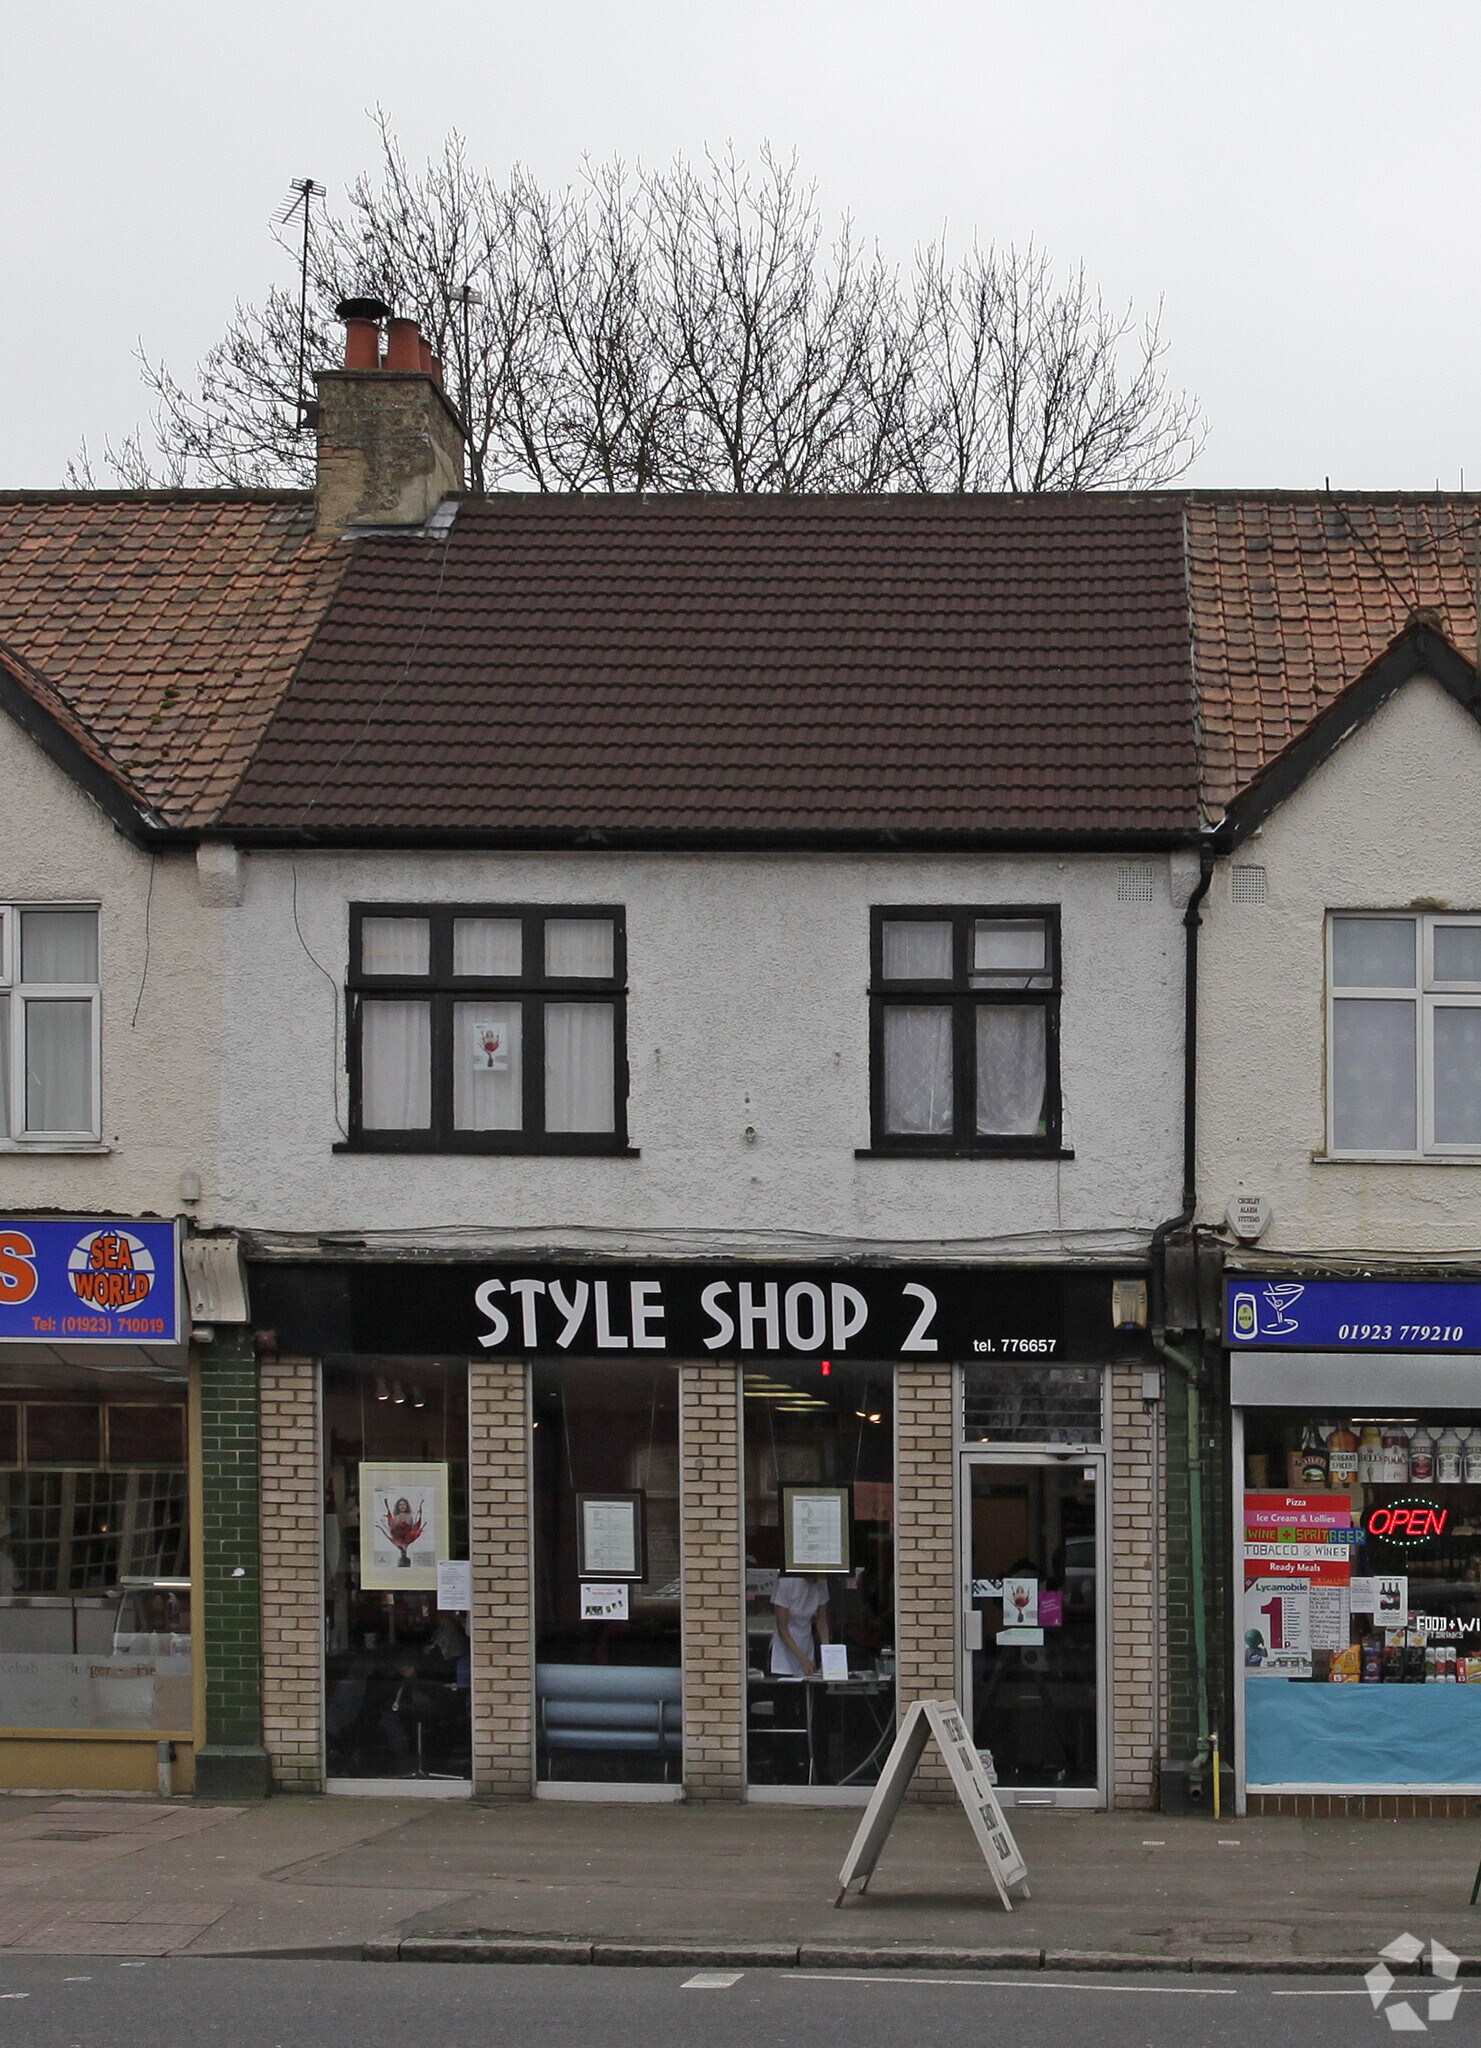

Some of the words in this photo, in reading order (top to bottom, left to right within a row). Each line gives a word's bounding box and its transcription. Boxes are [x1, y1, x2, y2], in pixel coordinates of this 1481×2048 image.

[1240, 1206, 1258, 1214] ALARM
[1237, 1215, 1261, 1223] SYSTEMS
[89, 1235, 134, 1270] SEA
[73, 1272, 150, 1307] WORLD
[474, 1278, 667, 1349] STYLE
[700, 1280, 869, 1351] SHOP
[900, 1283, 939, 1352] 2
[32, 1317, 56, 1331] Tel:
[61, 1317, 113, 1335] (01923)
[118, 1318, 165, 1333] 710019
[1338, 1324, 1393, 1340] 01923
[1399, 1325, 1464, 1342] 779210
[972, 1338, 996, 1353] tel.
[1000, 1338, 1057, 1353] 776657
[1285, 1497, 1307, 1507] Pizza
[1256, 1514, 1269, 1523] Ice
[1270, 1514, 1298, 1523] Cream
[1299, 1515, 1308, 1523] &
[1309, 1515, 1336, 1524] Lollies
[1368, 1509, 1448, 1536] OPEN
[1328, 1530, 1366, 1544] BEER
[1244, 1544, 1299, 1556] TOBACCO
[1303, 1545, 1312, 1556] &
[1269, 1563, 1295, 1574] Ready
[1297, 1564, 1321, 1573] Meals
[1260, 1597, 1283, 1649] 1
[1416, 1616, 1447, 1632] FOOD
